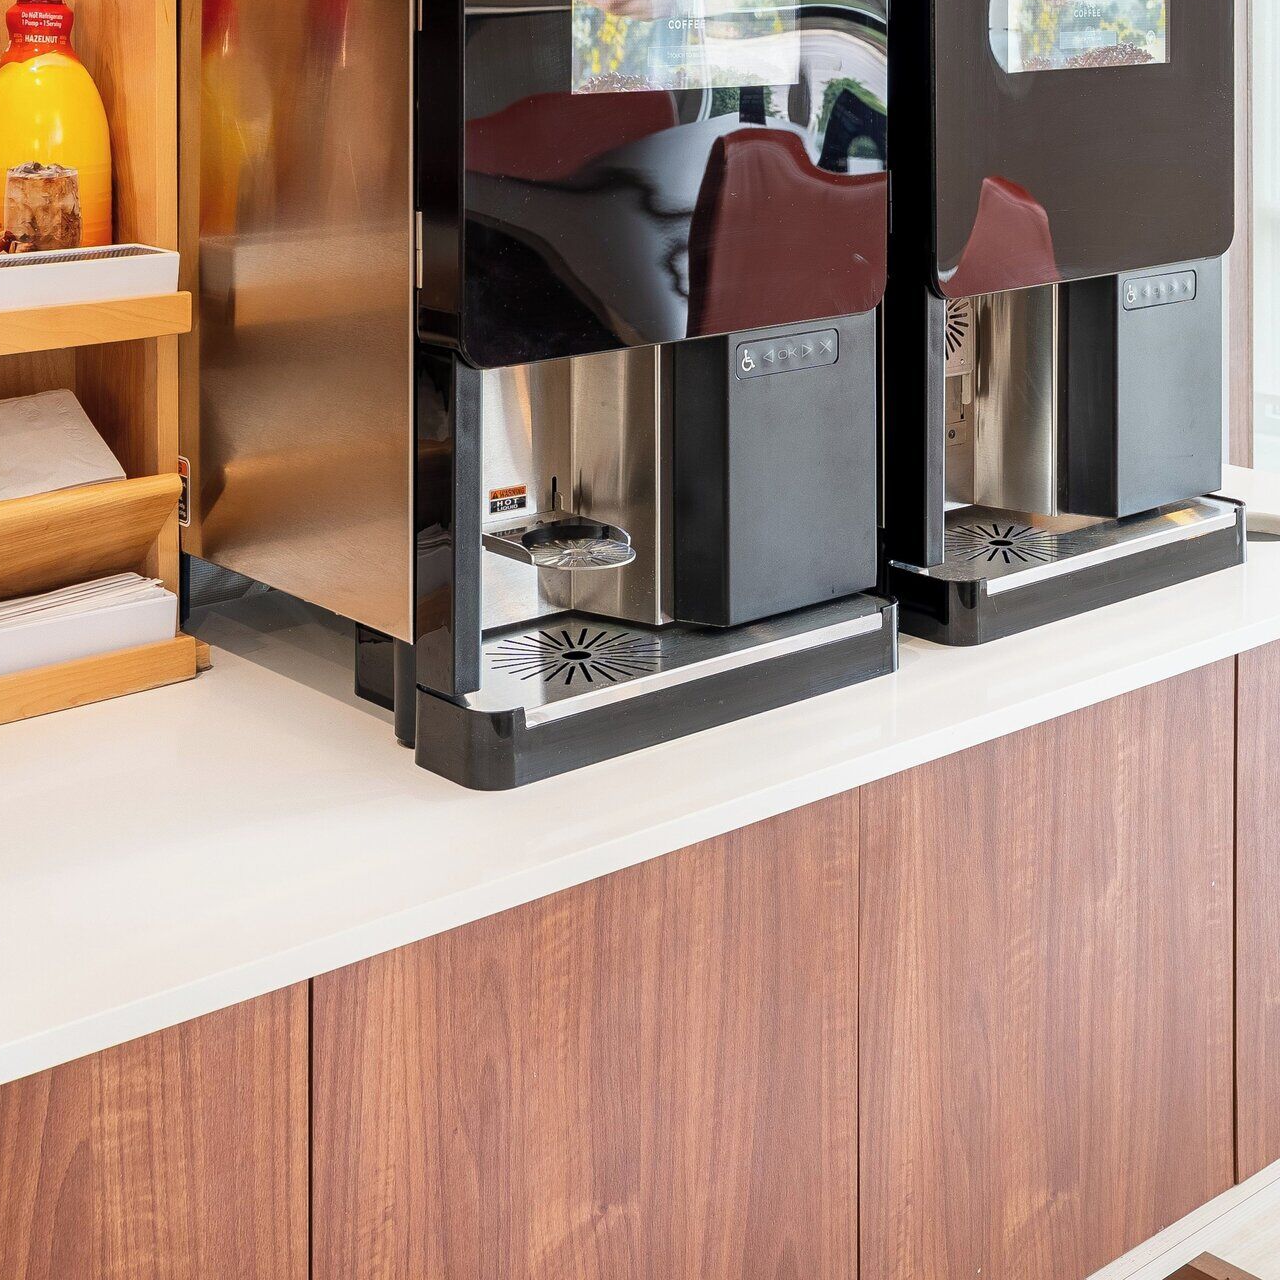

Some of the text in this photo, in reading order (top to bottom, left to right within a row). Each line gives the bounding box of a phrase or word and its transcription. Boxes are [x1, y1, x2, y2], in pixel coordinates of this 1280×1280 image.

[1073, 9, 1101, 18] COFFEE
[668, 20, 705, 29] COFFEE
[24, 34, 58, 44] HAZELNUT
[777, 347, 797, 360] OK
[496, 498, 519, 507] HOT
[497, 504, 518, 512] LIQUID
